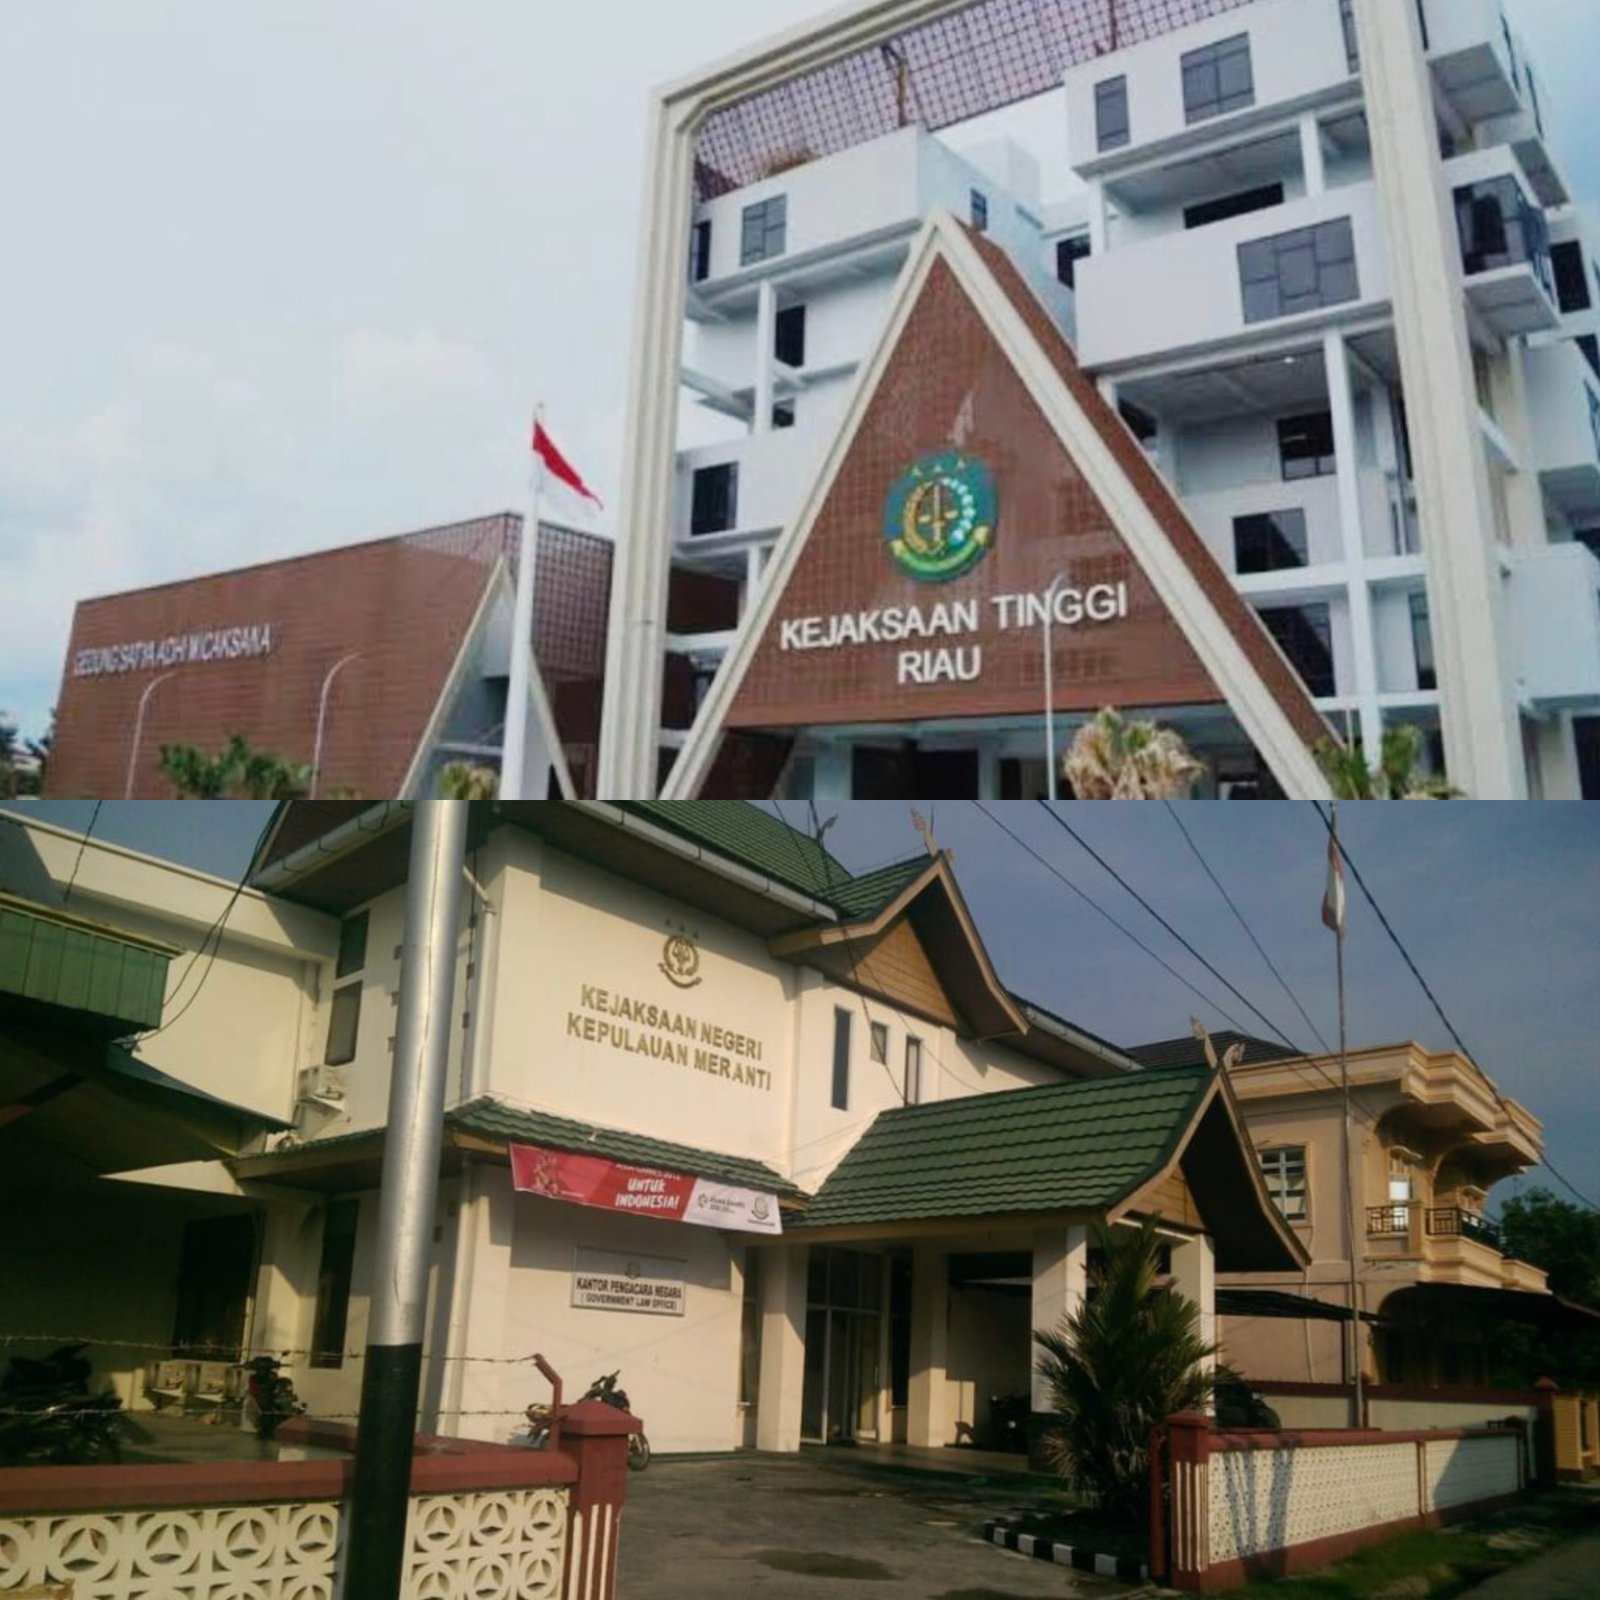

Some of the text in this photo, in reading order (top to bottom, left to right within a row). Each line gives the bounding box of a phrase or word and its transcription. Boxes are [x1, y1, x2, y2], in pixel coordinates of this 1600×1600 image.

[780, 581, 1127, 650] KEJAKSAAN TINGGI
[898, 645, 982, 684] RIAU
[581, 983, 762, 1061] KEJAKSAAN NEGERI
[566, 1012, 771, 1091] KEPULAUAN MERANTI
[627, 1177, 666, 1193] UNTUK
[614, 1193, 680, 1211] INDONESIA!
[577, 1277, 682, 1299] KANTOR PENGACARA NEGARA
[636, 1297, 651, 1307] LAW
